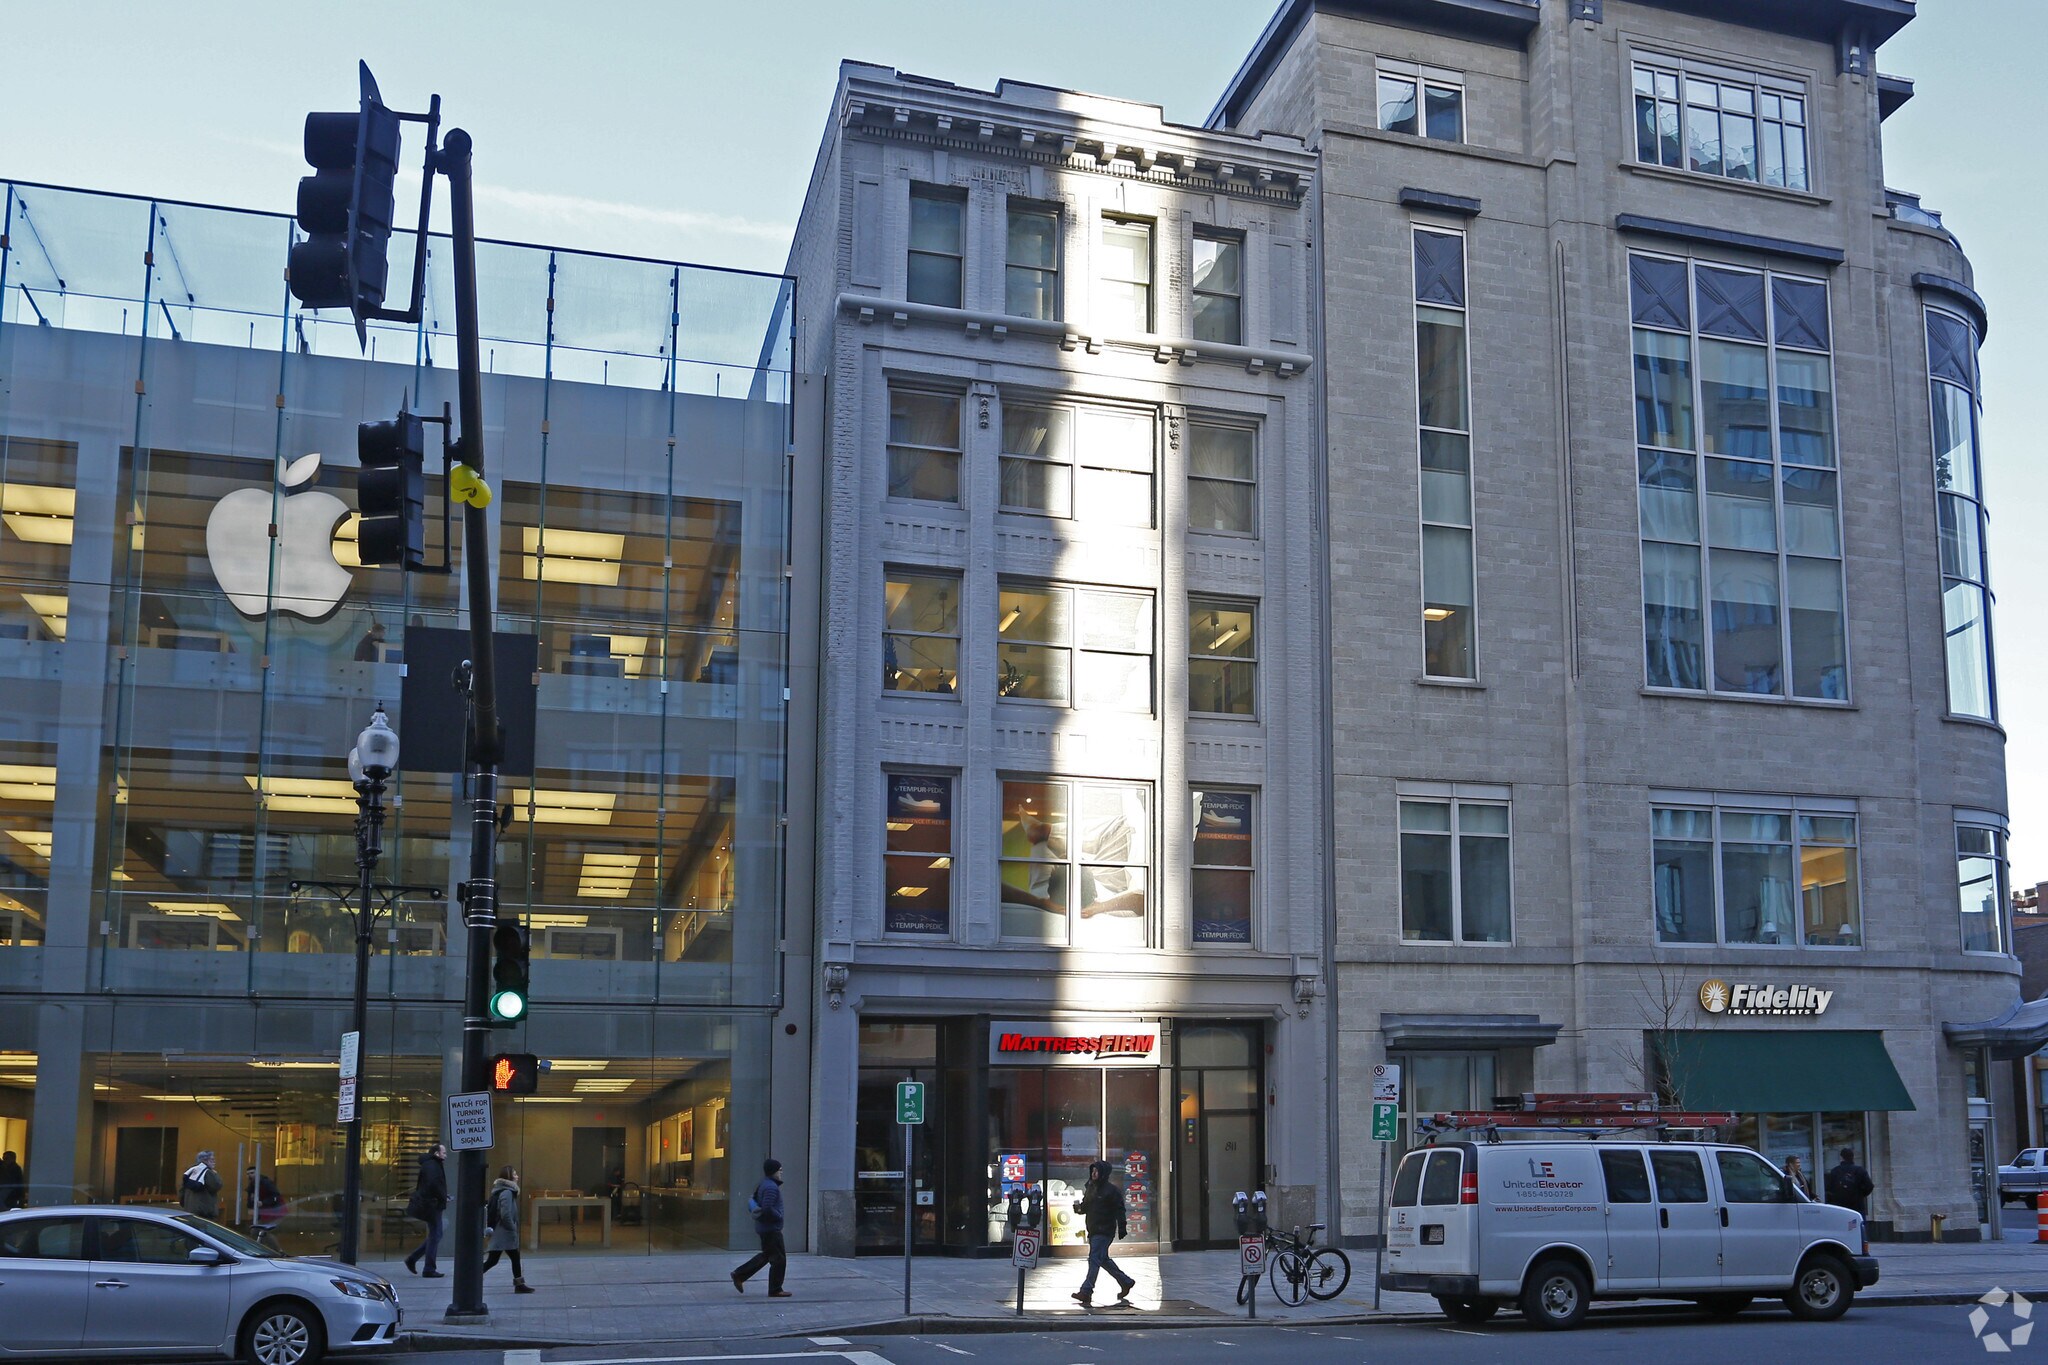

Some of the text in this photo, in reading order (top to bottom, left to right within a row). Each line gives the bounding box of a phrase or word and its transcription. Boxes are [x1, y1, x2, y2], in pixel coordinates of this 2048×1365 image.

[895, 922, 943, 930] TEMPUR-PEDIC
[1730, 984, 1833, 1014] Fidelity
[905, 1085, 917, 1099] P
[451, 1100, 473, 1108] WATCH
[456, 1109, 484, 1117] TURNING
[1380, 1105, 1391, 1119] P
[455, 1117, 487, 1126] VEHICLES
[460, 1136, 484, 1145] SIGNAL
[1225, 1141, 1237, 1152] 811
[1502, 1180, 1584, 1189] UnitedElevator
[1495, 1205, 1598, 1213] www.UnitedElevatorCorp.com
